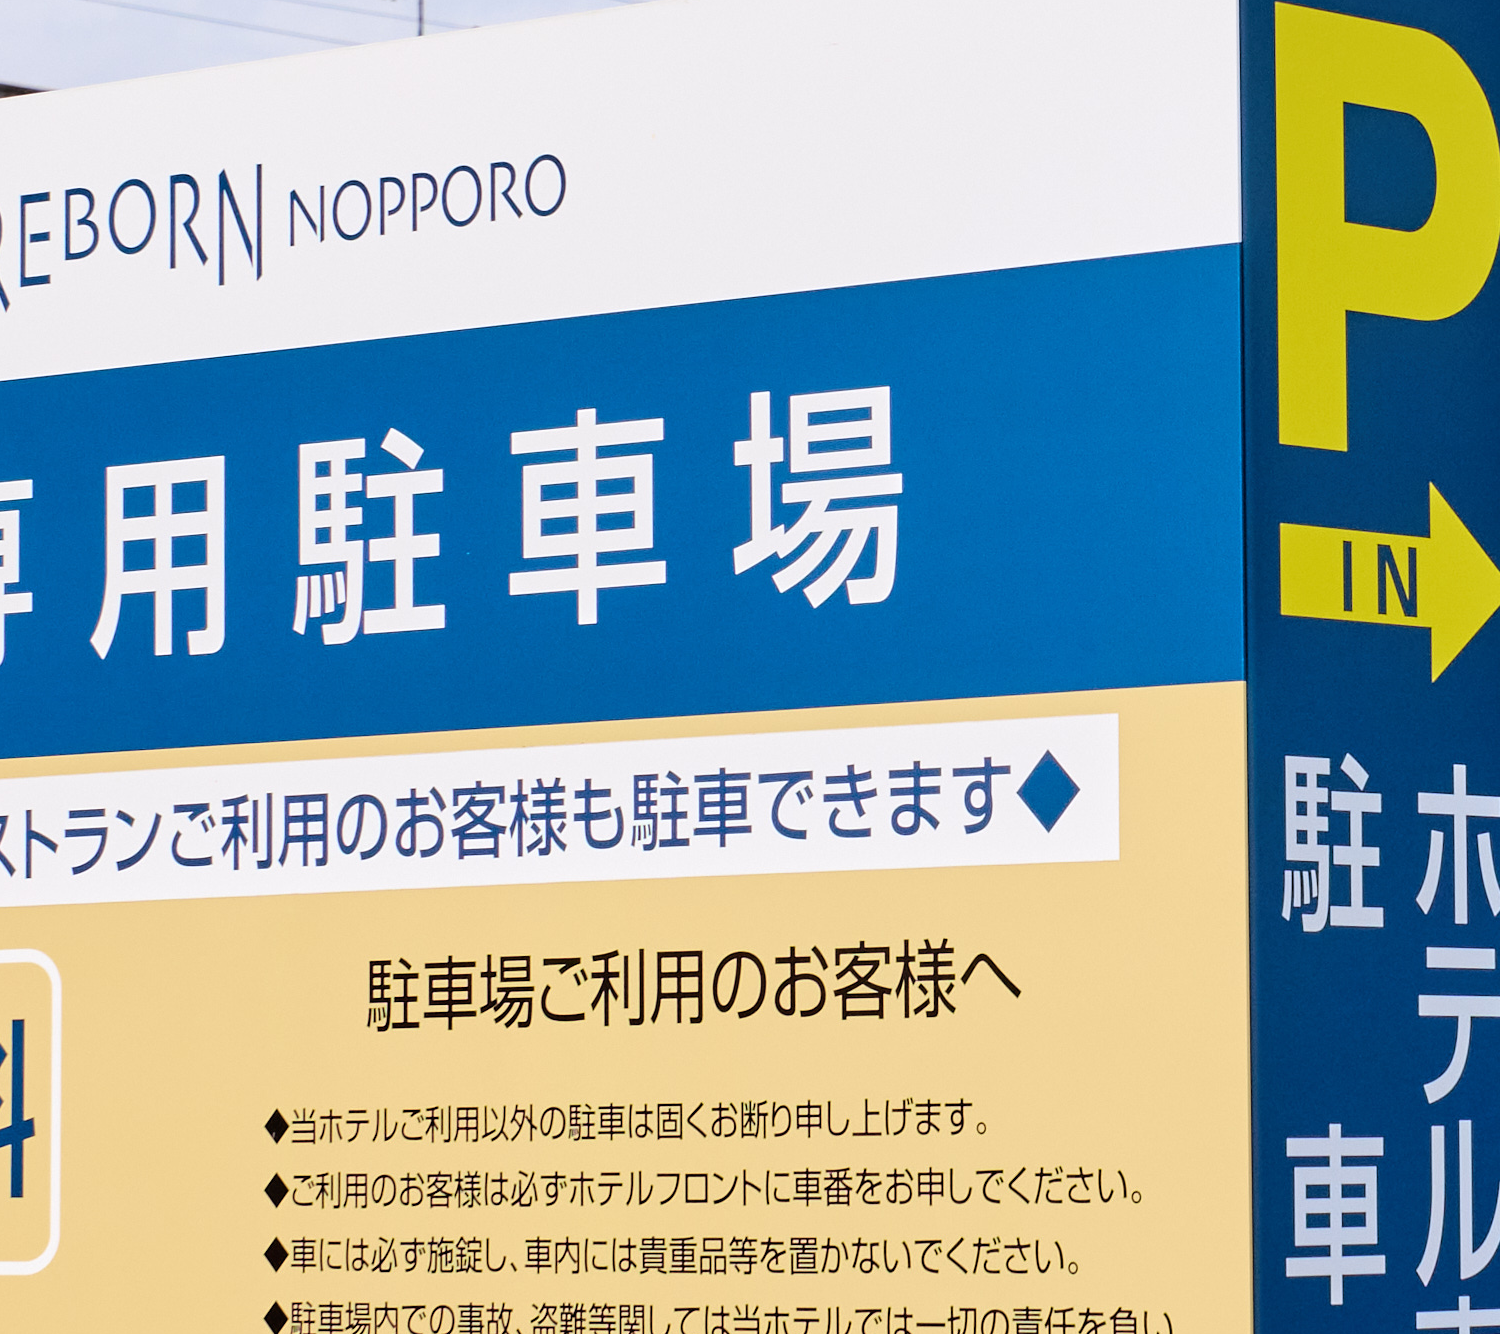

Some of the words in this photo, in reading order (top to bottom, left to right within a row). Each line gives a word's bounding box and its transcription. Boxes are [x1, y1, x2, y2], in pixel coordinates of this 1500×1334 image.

[289, 153, 567, 248] NOPPORO
[1342, 540, 1419, 619] IN
[366, 936, 1023, 1034] 駐車場ご利用のお客様へ
[290, 1097, 988, 1146] 当ホテルご利用以外の駐車は固くお断り申し上げます。
[289, 1235, 1080, 1276] 車には必ず施錠し、車内には貴重品等を置かないでください。
